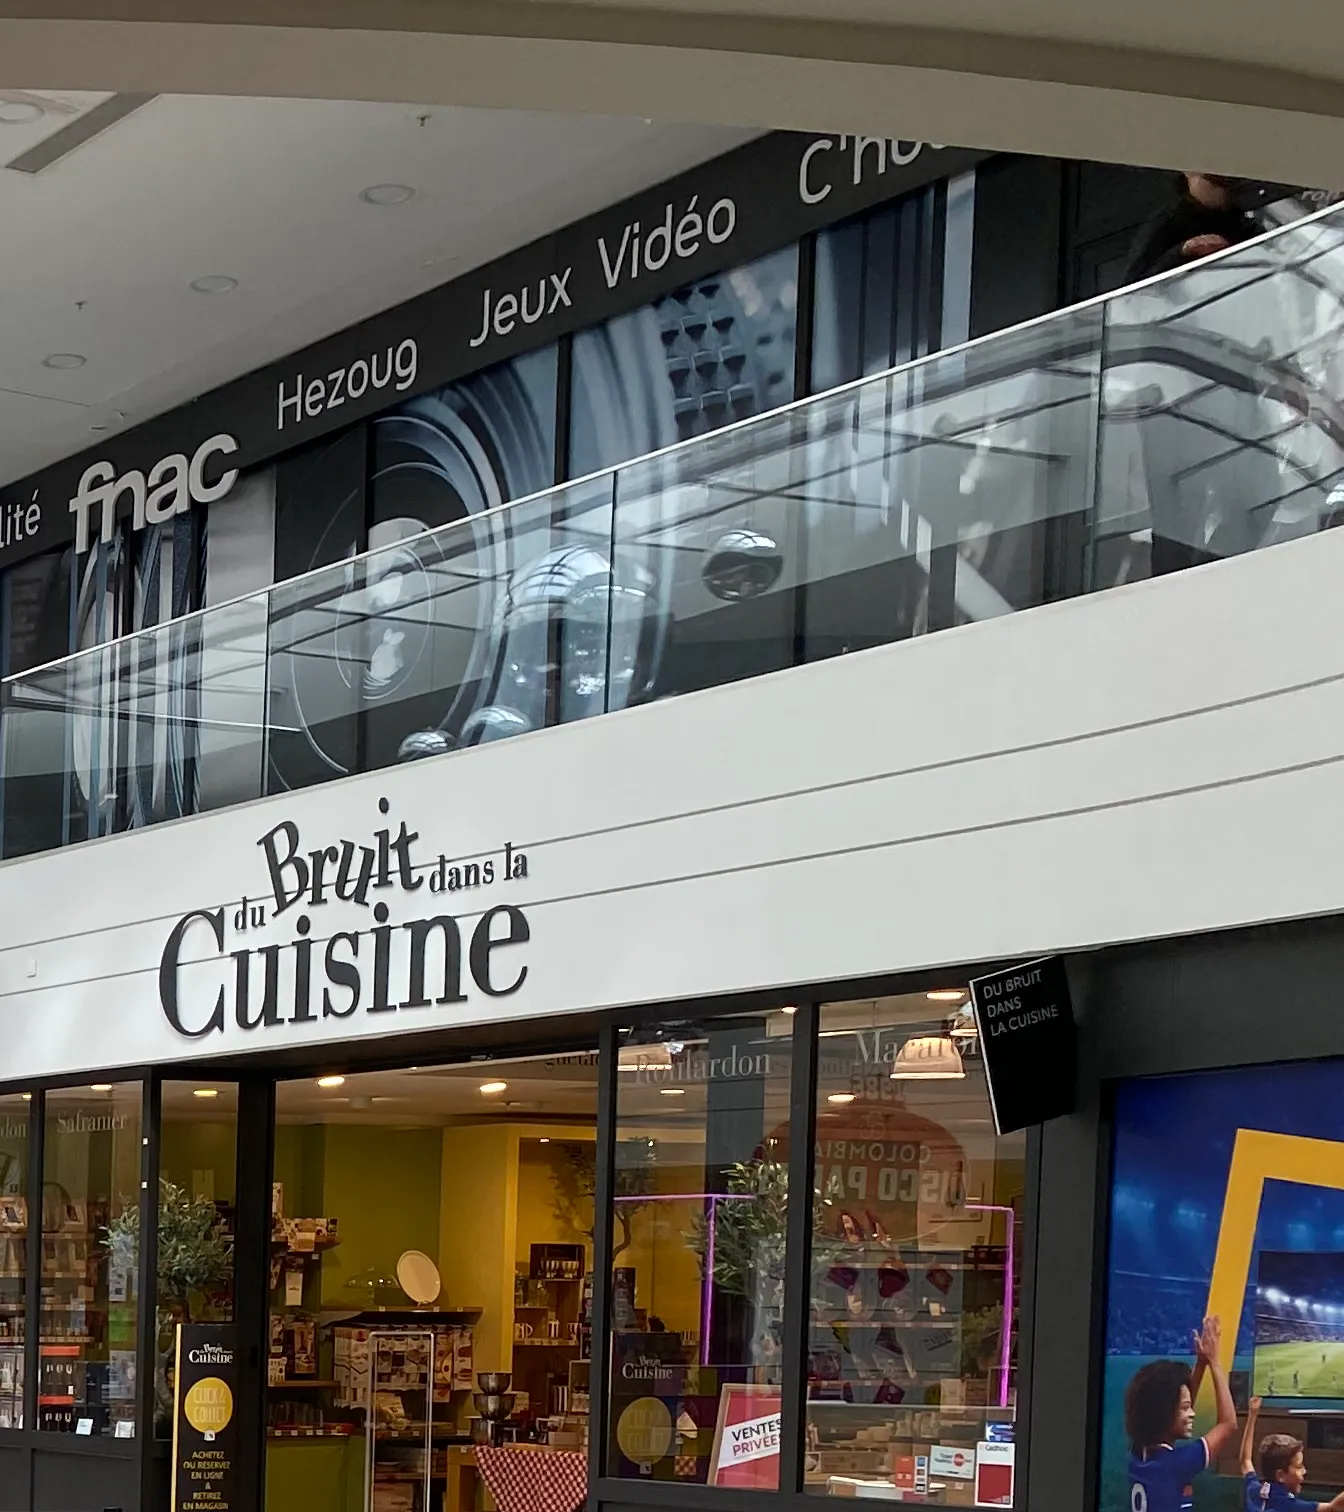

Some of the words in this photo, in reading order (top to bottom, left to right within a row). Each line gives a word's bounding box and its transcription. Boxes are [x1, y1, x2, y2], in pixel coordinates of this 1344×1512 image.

[469, 266, 573, 348] Jeux
[597, 194, 737, 289] Vidéo
[277, 338, 418, 431] Hezoug
[69, 433, 240, 554] fnac
[234, 896, 267, 931] du
[256, 796, 425, 918] Bruit
[428, 854, 496, 894] dans
[504, 841, 529, 882] la
[158, 901, 531, 1037] Cuisine
[983, 981, 1003, 999] DU
[1005, 968, 1042, 992] BRUIT
[986, 995, 1022, 1018] DANS
[990, 1021, 1008, 1036] LA
[1008, 1004, 1059, 1030] CUISINE
[188, 1349, 233, 1364] Cuisine
[621, 1362, 673, 1380] Cuisine
